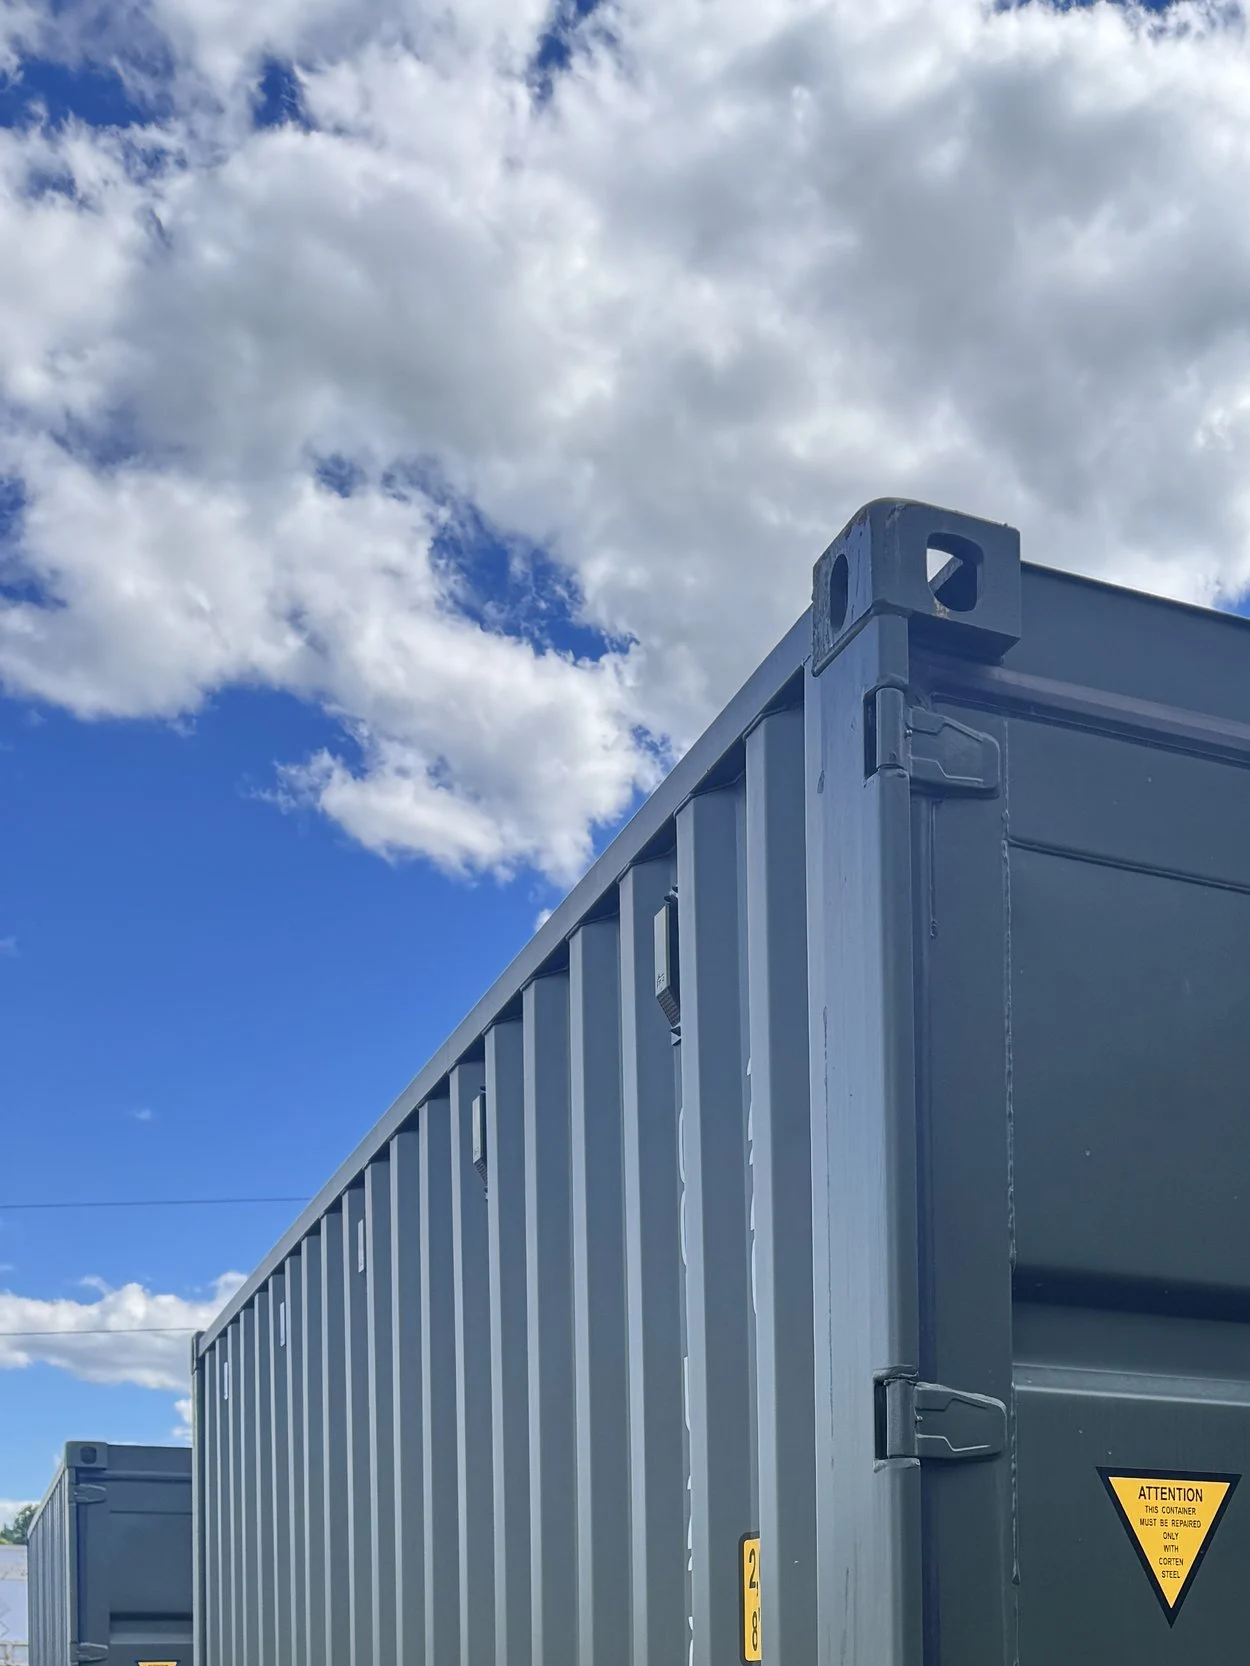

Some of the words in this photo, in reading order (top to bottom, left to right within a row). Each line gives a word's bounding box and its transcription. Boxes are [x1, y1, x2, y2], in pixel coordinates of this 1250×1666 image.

[1138, 1485, 1204, 1502] ATTENTION
[1145, 1505, 1159, 1514] THIS
[1162, 1506, 1197, 1516] CONTAINER
[1139, 1518, 1157, 1527] MUST
[1160, 1518, 1169, 1528] BE
[1171, 1519, 1202, 1529] REPAIRED
[1162, 1532, 1179, 1541] ONLY
[1163, 1545, 1179, 1554] WITH
[1158, 1557, 1184, 1566] CORTEN
[1161, 1570, 1181, 1579] STEEL
